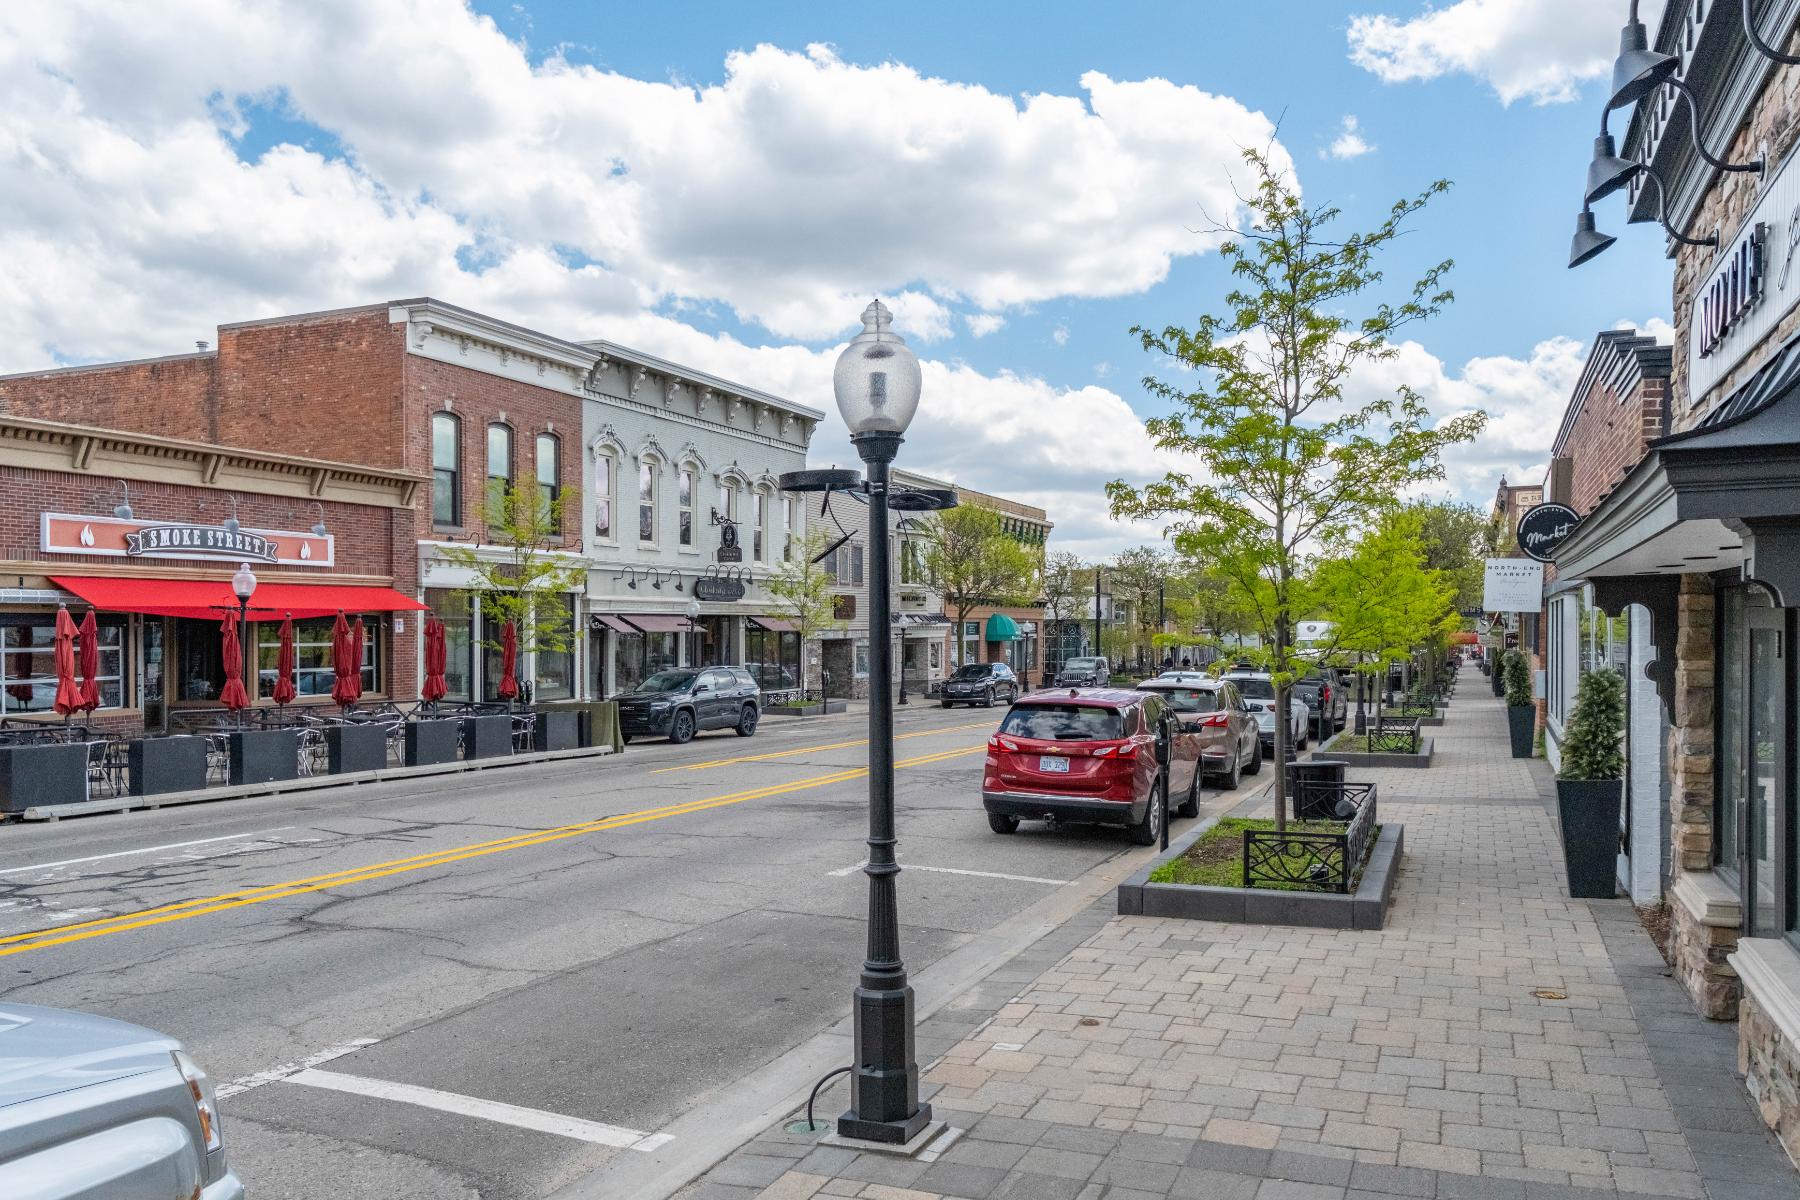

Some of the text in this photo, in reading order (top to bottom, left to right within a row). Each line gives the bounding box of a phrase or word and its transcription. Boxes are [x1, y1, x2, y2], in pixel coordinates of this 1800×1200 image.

[150, 529, 261, 553] SMOKE STREET
[1526, 522, 1574, 547] Market
